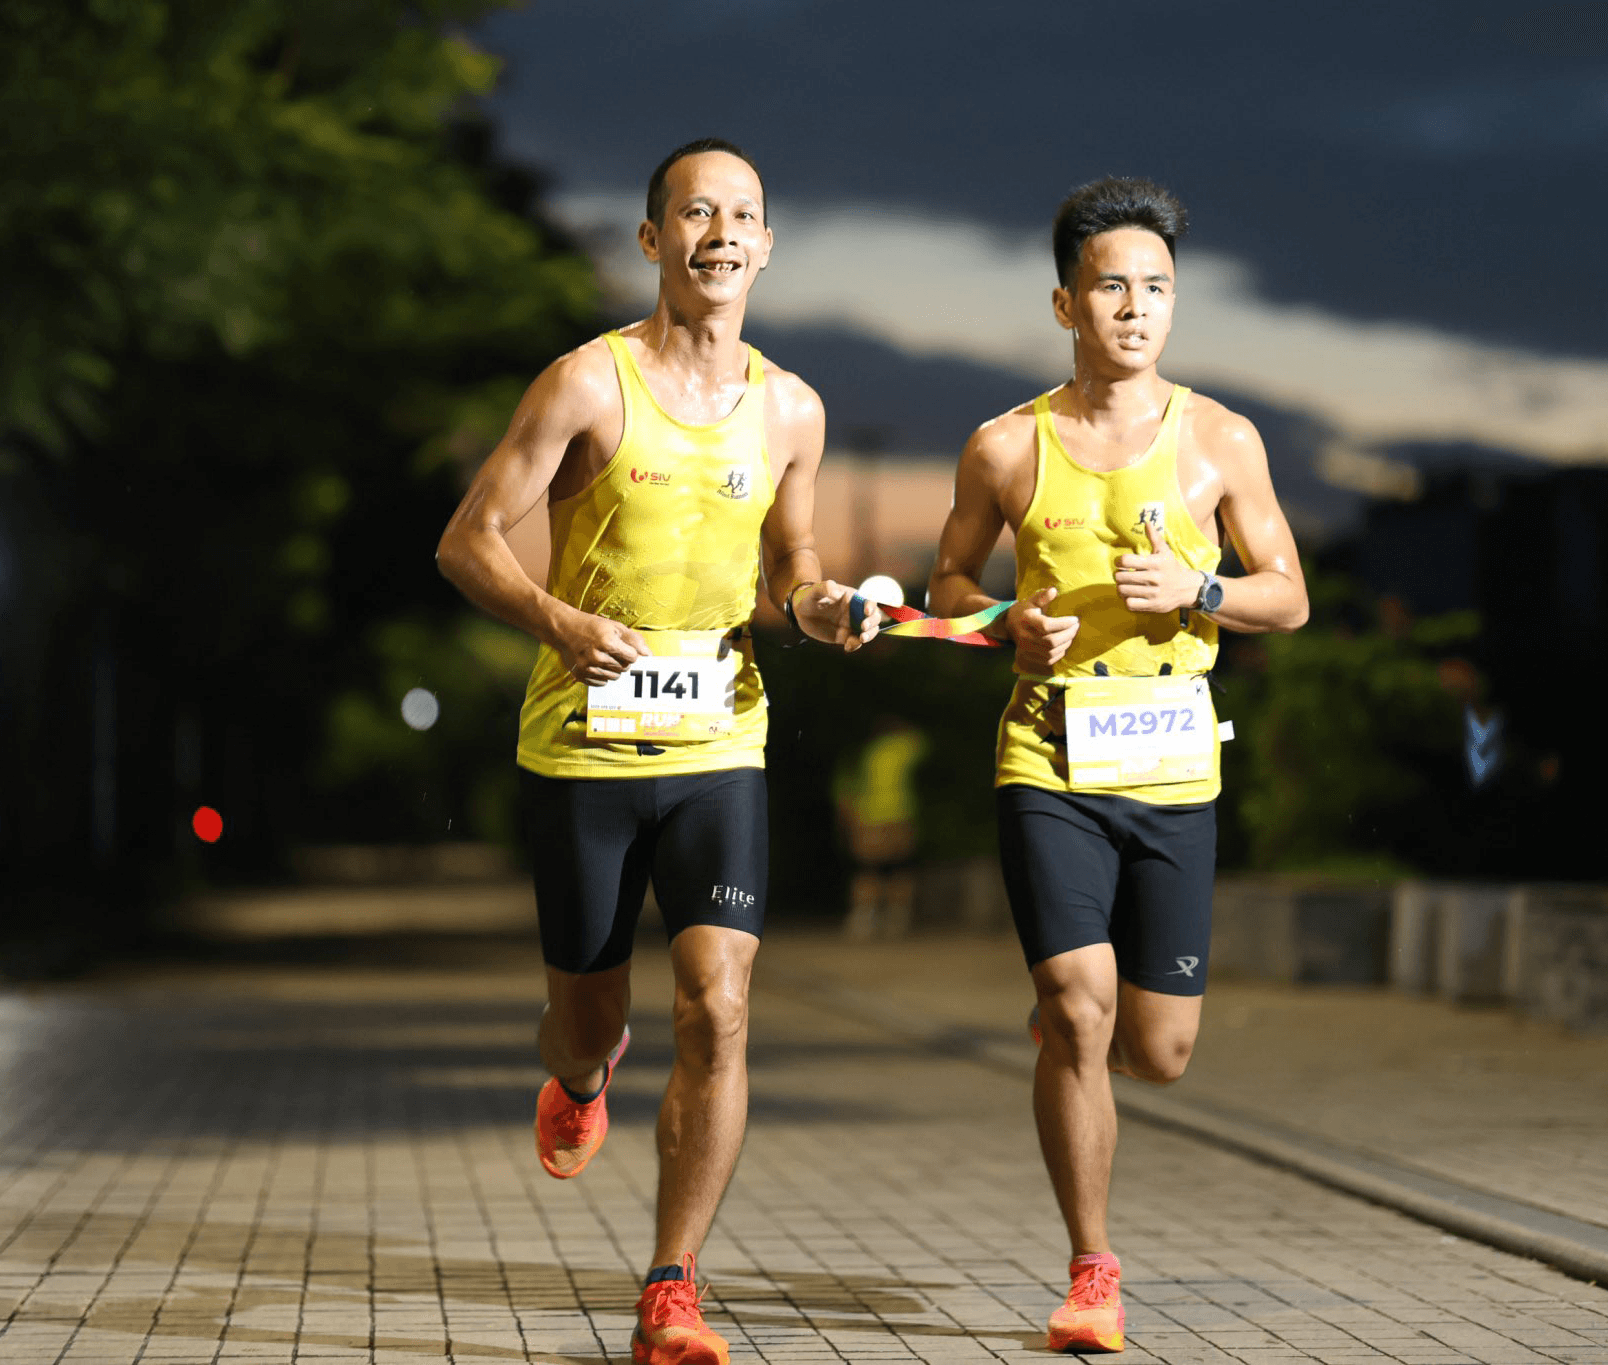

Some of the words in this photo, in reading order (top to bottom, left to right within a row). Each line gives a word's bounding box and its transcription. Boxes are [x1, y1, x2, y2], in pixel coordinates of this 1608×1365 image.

[630, 670, 698, 699] 1141
[1089, 708, 1195, 738] M2972
[711, 884, 755, 905] Elite
